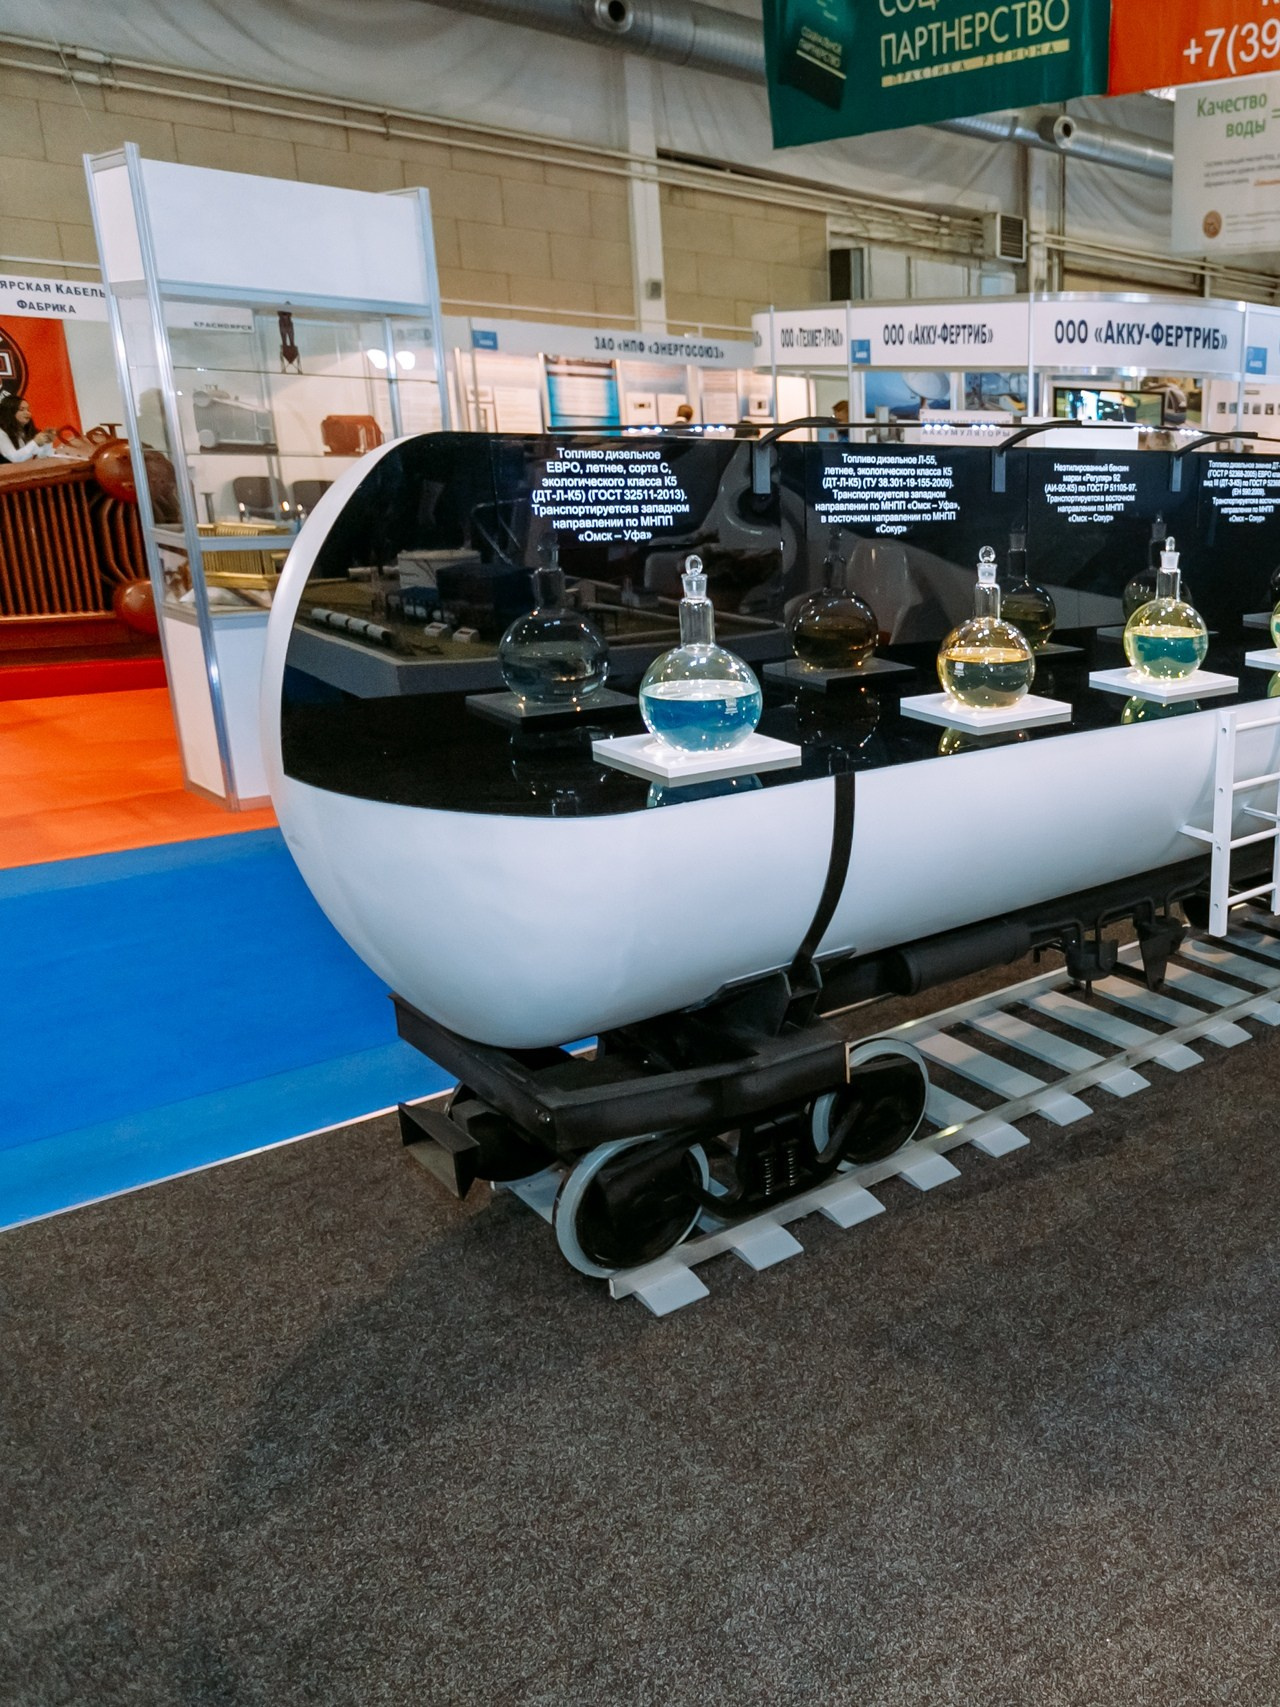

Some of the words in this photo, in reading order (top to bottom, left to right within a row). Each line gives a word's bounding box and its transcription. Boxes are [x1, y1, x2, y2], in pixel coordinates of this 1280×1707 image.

[880, 0, 1070, 67] ПАРТНЕРСТВО
[1196, 92, 1268, 118] Качество
[1225, 119, 1266, 139] воды
[17, 300, 76, 314] ФАБРИКА
[194, 322, 252, 330] КРАСНОЯРСК
[781, 328, 794, 347] ООО
[883, 324, 904, 345] ООО
[908, 322, 993, 345] «АККУ-ФЕРТРИБ»
[1055, 319, 1088, 344] ООО
[1094, 320, 1228, 350] «АККУ-ФЕРТРИБ»
[594, 337, 614, 350] ЗАО
[618, 339, 645, 353] «НПФ
[649, 342, 724, 359] «ЭНЕРГОСОЮЗ»
[556, 448, 604, 459] Топливо
[605, 450, 661, 461] дизельное
[842, 453, 876, 463] Топливо
[877, 455, 917, 465] дизельное
[918, 455, 937, 465] Л-55,
[546, 462, 583, 473] ЕВРО,
[586, 464, 626, 474] летнее,
[629, 464, 658, 474] сорта
[660, 463, 672, 474] С,
[824, 467, 856, 476] летнее,
[857, 468, 915, 477] экологического
[917, 468, 941, 476] класса
[943, 467, 952, 475] К5
[542, 477, 625, 488] экологического
[627, 477, 662, 486] класса
[664, 476, 677, 486] К5
[823, 478, 861, 489] (ДТ-Л-К5)
[863, 478, 876, 489] (ТУ
[1113, 474, 1121, 482] 92
[1087, 484, 1103, 492] ГОСТ
[1104, 484, 1109, 492] Р
[532, 490, 585, 503] (ДТ-Л-К5)
[588, 490, 622, 503] (ГОСТ
[624, 489, 687, 502] 32511-2013).
[832, 489, 905, 501] Транспортируется
[911, 491, 946, 499] западном
[532, 504, 633, 517] Транспортируется
[633, 505, 639, 513] в
[641, 504, 689, 514] западном
[815, 503, 868, 512] направлении
[881, 502, 906, 510] МНПП
[907, 501, 931, 510] «Омск
[821, 515, 826, 523] в
[828, 514, 870, 523] восточном
[872, 513, 921, 523] направлении
[922, 513, 931, 521] по
[933, 511, 956, 521] МНПП
[553, 519, 623, 531] направлении
[626, 518, 638, 527] по
[640, 516, 673, 526] МНПП
[876, 524, 907, 535] «Сокур»
[578, 531, 613, 542] «Омск
[623, 530, 652, 542] Уфа»
